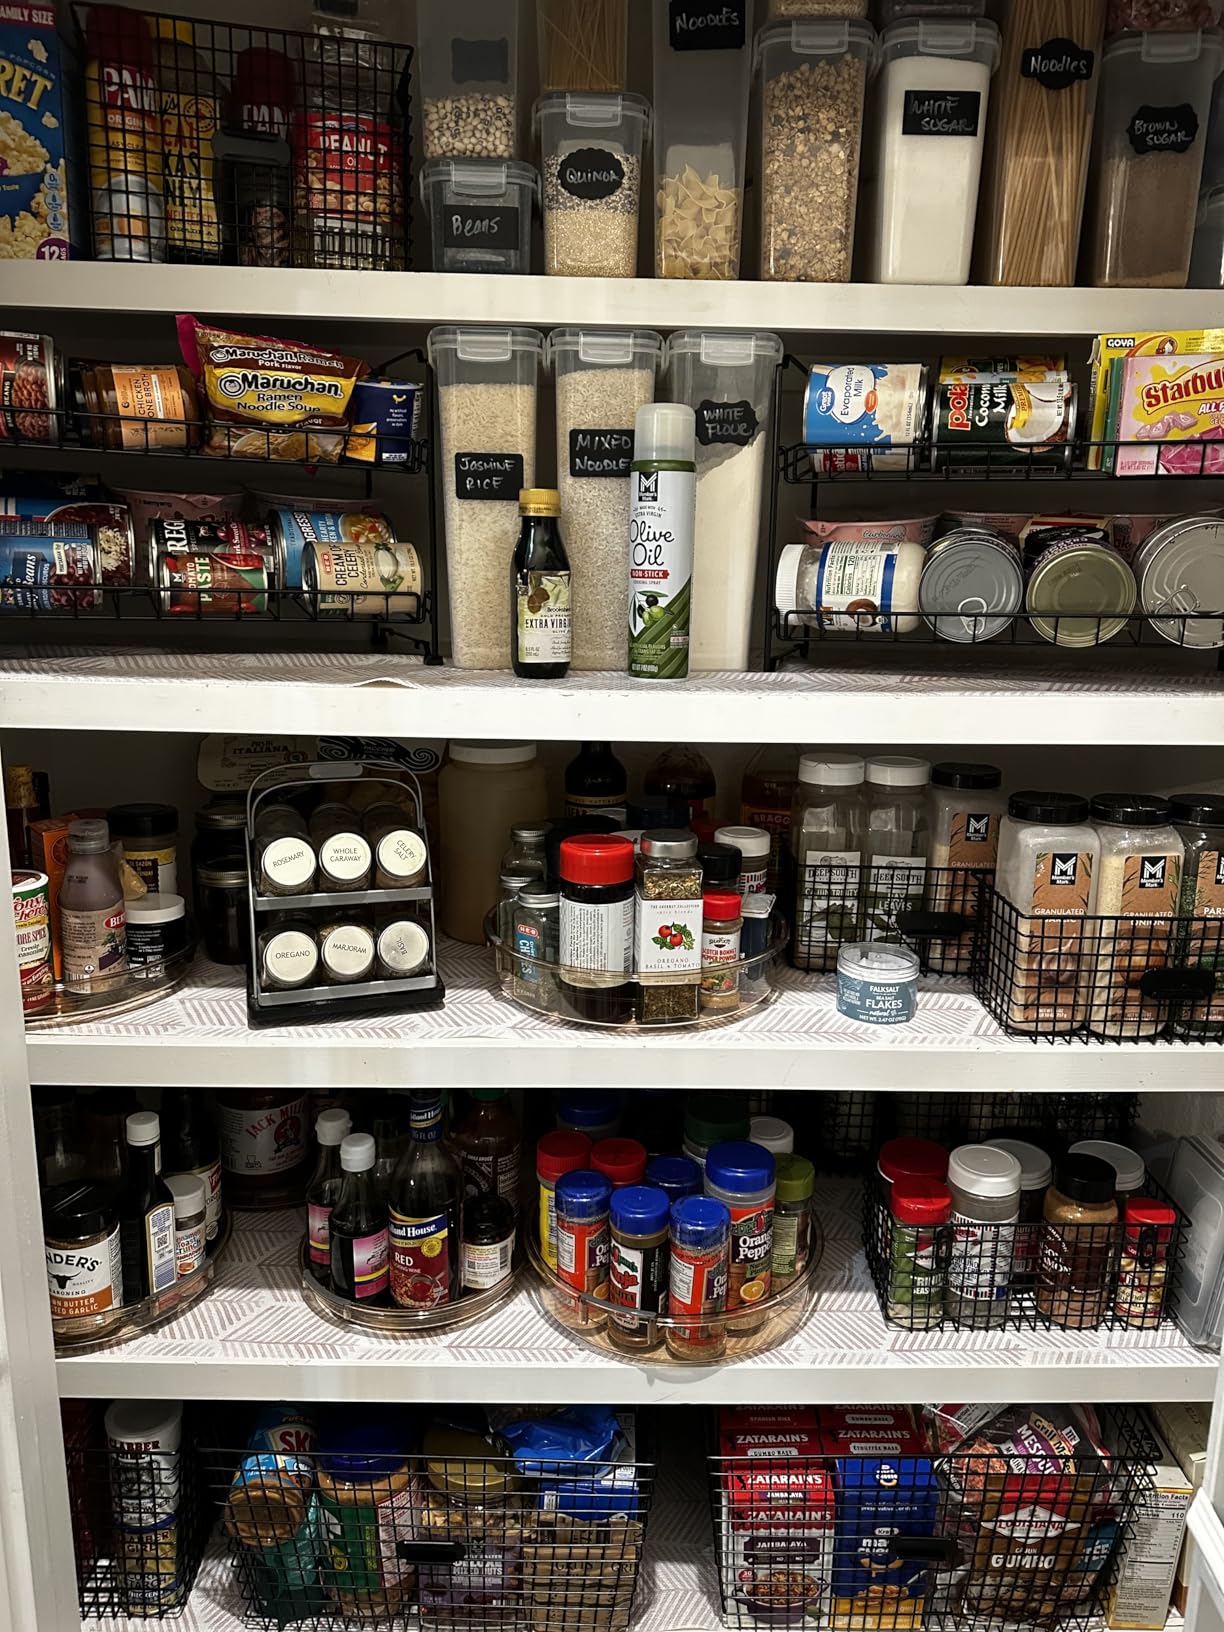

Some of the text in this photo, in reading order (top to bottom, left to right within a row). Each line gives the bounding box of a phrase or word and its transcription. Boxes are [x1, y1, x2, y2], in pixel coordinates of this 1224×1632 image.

[32, 10, 54, 25] SIZE
[674, 8, 740, 32] NOODLES
[1031, 55, 1087, 74] Noodles
[103, 67, 157, 115] PAM
[909, 95, 959, 116] WHITE
[921, 118, 974, 133] SUGAR
[1145, 130, 1192, 145] SUGAR
[319, 134, 388, 165] PEANUT
[452, 214, 500, 237] Beans
[42, 245, 60, 260] 12
[1107, 338, 1135, 348] GOYA
[258, 360, 280, 368] Pork
[297, 353, 344, 370] Ramen
[142, 373, 152, 398] BROTH
[840, 367, 855, 416] Evaporated
[853, 379, 864, 397] Milk
[133, 378, 146, 416] CHICKEN
[257, 392, 303, 402] Ramen
[993, 384, 1008, 413] Milk
[237, 401, 286, 412] Noodle
[1198, 402, 1217, 415] ALL
[703, 408, 744, 422] WHITE
[706, 422, 752, 437] FLOUR
[575, 433, 631, 451] MIXED
[466, 476, 504, 491] RICE
[630, 519, 675, 543] Olive
[633, 543, 664, 566] Oil
[22, 554, 37, 585] Beans
[332, 554, 348, 586] CREAM
[344, 548, 360, 578] CELERY
[828, 555, 837, 570] Facts
[845, 555, 856, 595] Calories 120
[525, 618, 549, 629] EXTRA
[393, 849, 408, 861] SALT
[396, 840, 417, 860] CELERY
[273, 851, 305, 868] ROSEMARY
[31, 927, 46, 943] SPICE
[332, 943, 367, 954] MARJORAM
[397, 937, 408, 956] BASIL
[275, 950, 311, 960] OREGANO
[869, 985, 900, 993] FALKSALT
[865, 998, 903, 1009] FLAKES
[245, 1113, 277, 1139] JACK
[407, 1224, 437, 1238] House
[395, 1252, 414, 1267] RED
[64, 1297, 95, 1307] BUTTER
[69, 1303, 99, 1315] GARLIC
[838, 1429, 911, 1440] ZATARAIN'S
[1033, 1417, 1057, 1441] Grill
[736, 1433, 809, 1444] ZATARAIN'S
[747, 1475, 823, 1485] ZATARAIN'S
[747, 1511, 833, 1521] ZATARAIN'S
[991, 1555, 1056, 1569] GUMBO
